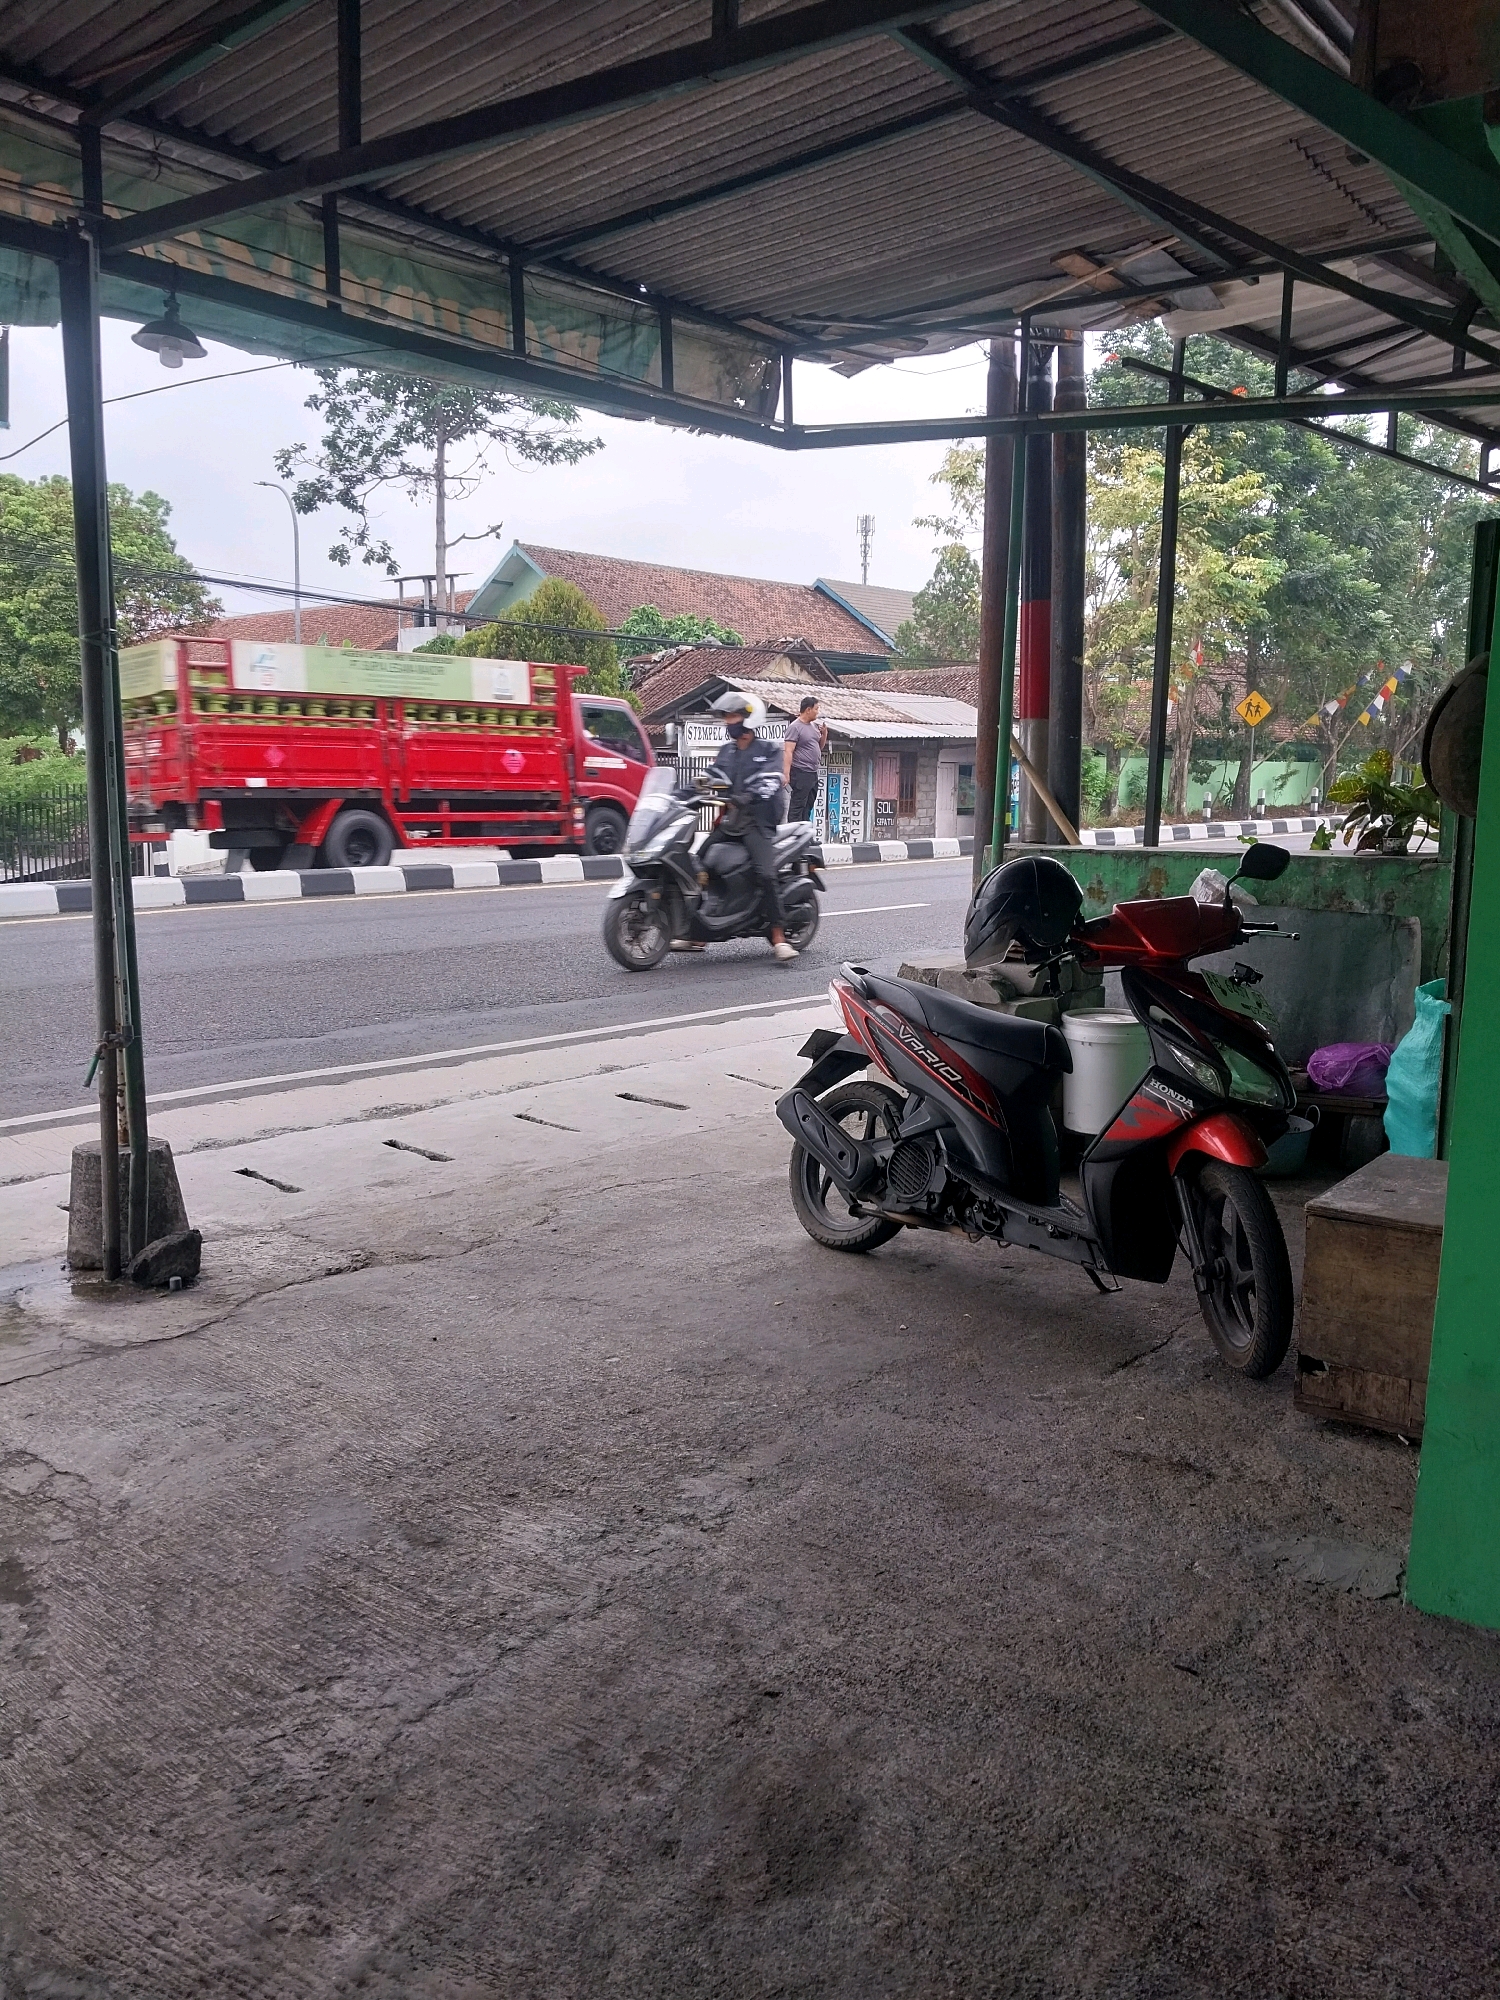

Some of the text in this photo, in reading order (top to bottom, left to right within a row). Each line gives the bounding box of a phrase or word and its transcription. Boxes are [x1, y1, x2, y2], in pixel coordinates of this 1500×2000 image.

[687, 726, 723, 741] STEMPEL
[754, 725, 787, 740] NOMOR
[829, 752, 852, 765] KUNCI
[876, 801, 894, 814] SOL
[850, 801, 862, 843] KUNCI
[898, 1024, 963, 1082] VARIO
[1149, 1078, 1195, 1109] HONDA
